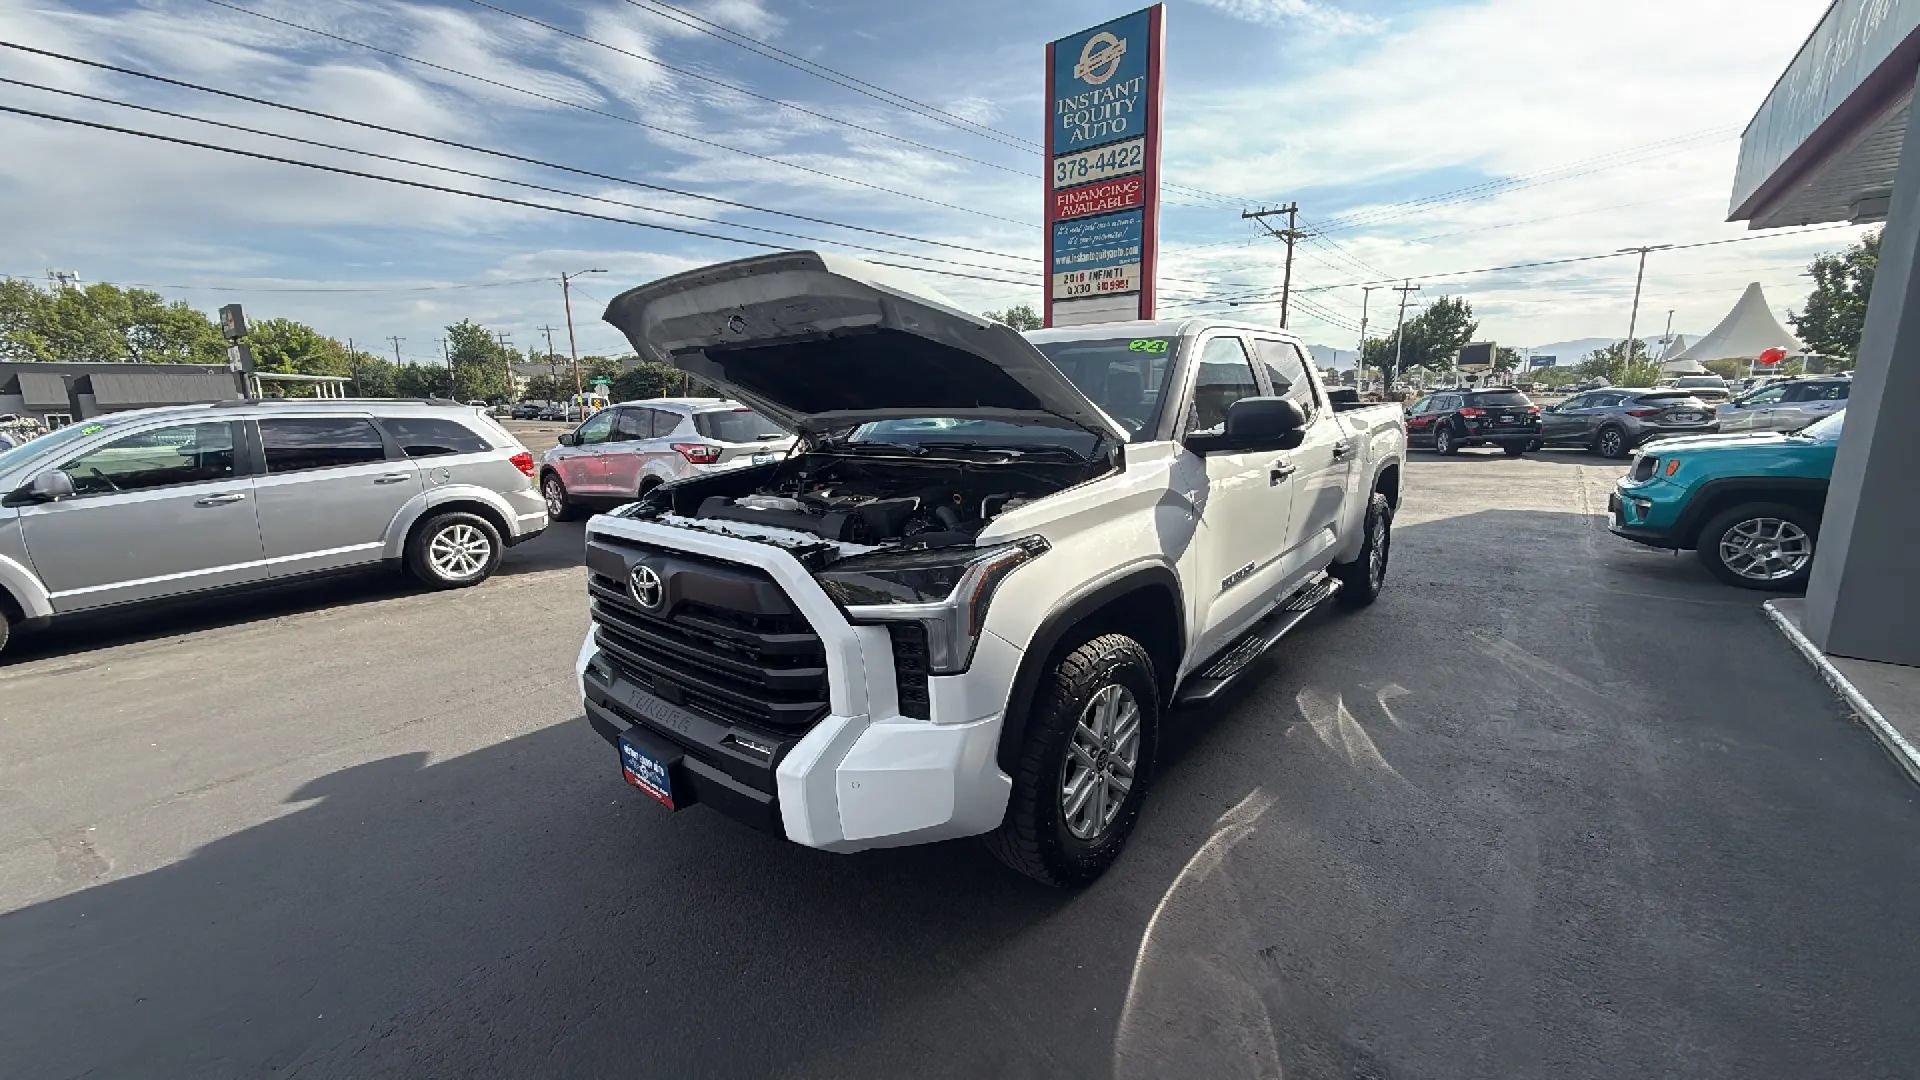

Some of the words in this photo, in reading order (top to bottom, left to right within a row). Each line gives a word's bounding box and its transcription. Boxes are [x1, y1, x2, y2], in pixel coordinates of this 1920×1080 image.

[1057, 76, 1144, 115] INSTANT
[1063, 96, 1137, 128] EQUITY
[1070, 118, 1127, 144] AUTO
[1057, 145, 1141, 182] 378-4422
[1057, 181, 1139, 206] FINANCING
[1061, 194, 1135, 216] AVAILABLE
[1131, 340, 1166, 352] 24
[628, 689, 694, 733] TUNDRA
